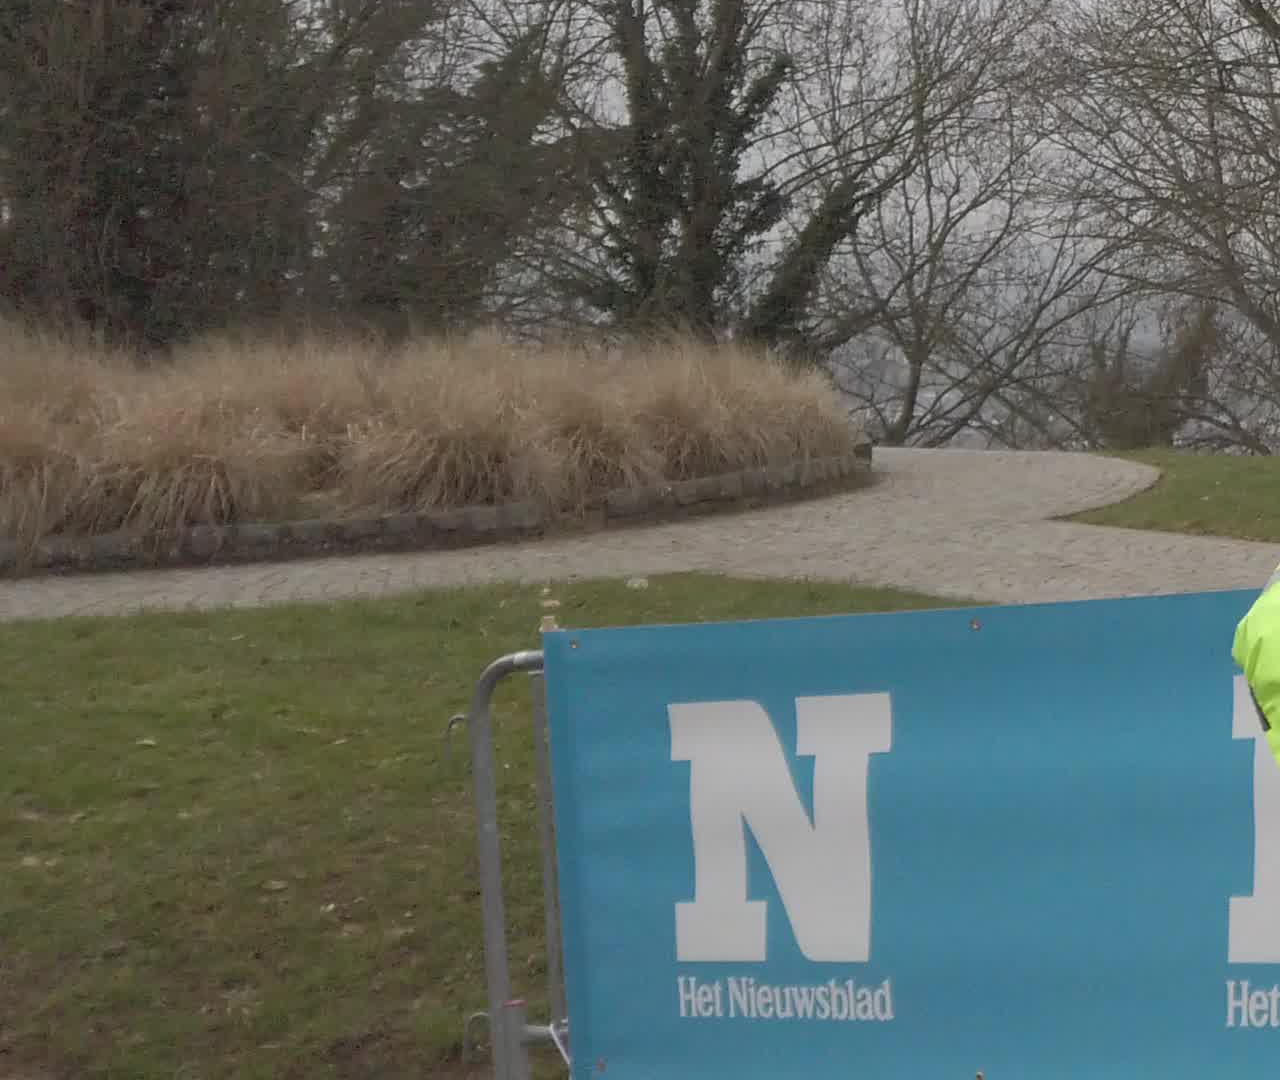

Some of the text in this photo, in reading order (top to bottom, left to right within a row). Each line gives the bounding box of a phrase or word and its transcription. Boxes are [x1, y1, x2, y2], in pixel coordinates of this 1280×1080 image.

[667, 691, 892, 963] N
[677, 975, 896, 1022] Het Nieuwsblad
[1225, 979, 1280, 1029] Het
